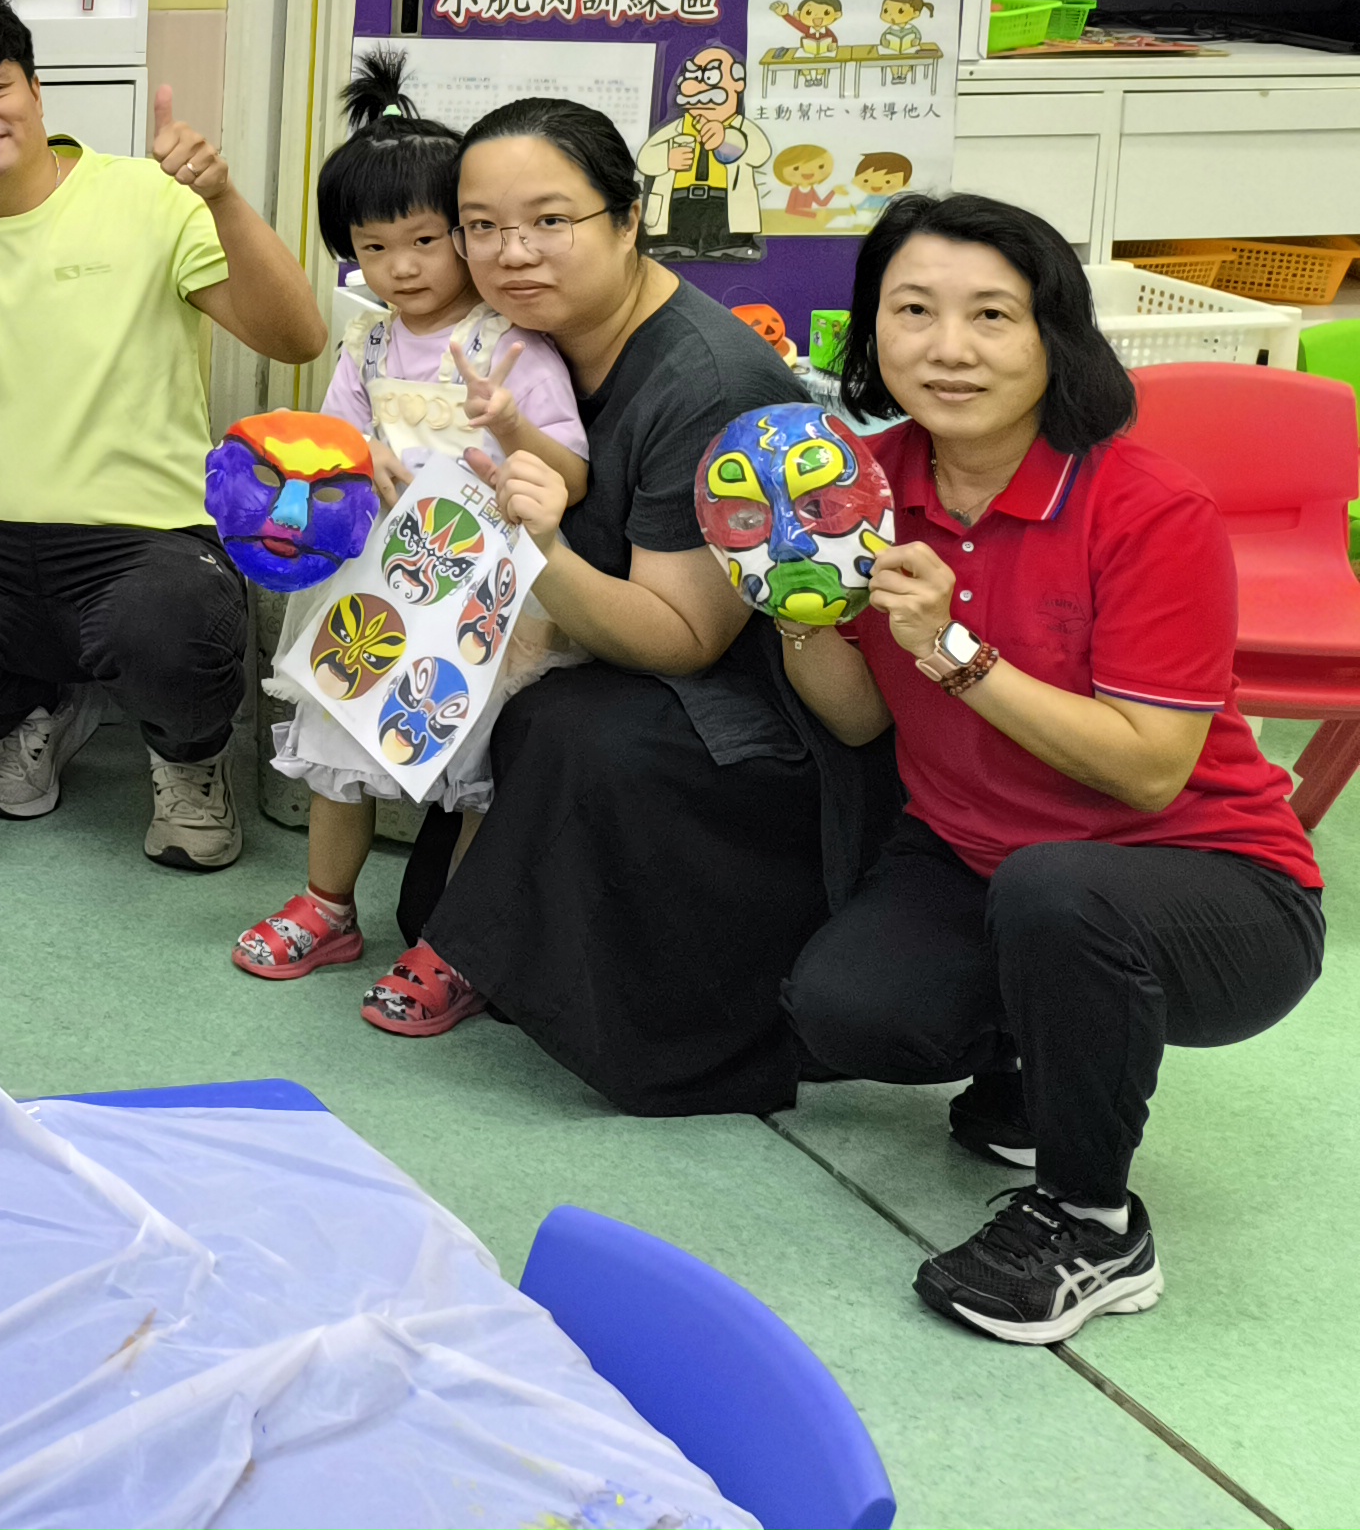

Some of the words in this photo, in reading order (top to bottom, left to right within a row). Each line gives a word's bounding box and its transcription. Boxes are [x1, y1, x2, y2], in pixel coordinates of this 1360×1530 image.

[753, 101, 942, 122] 主動幫忙、教導他人
